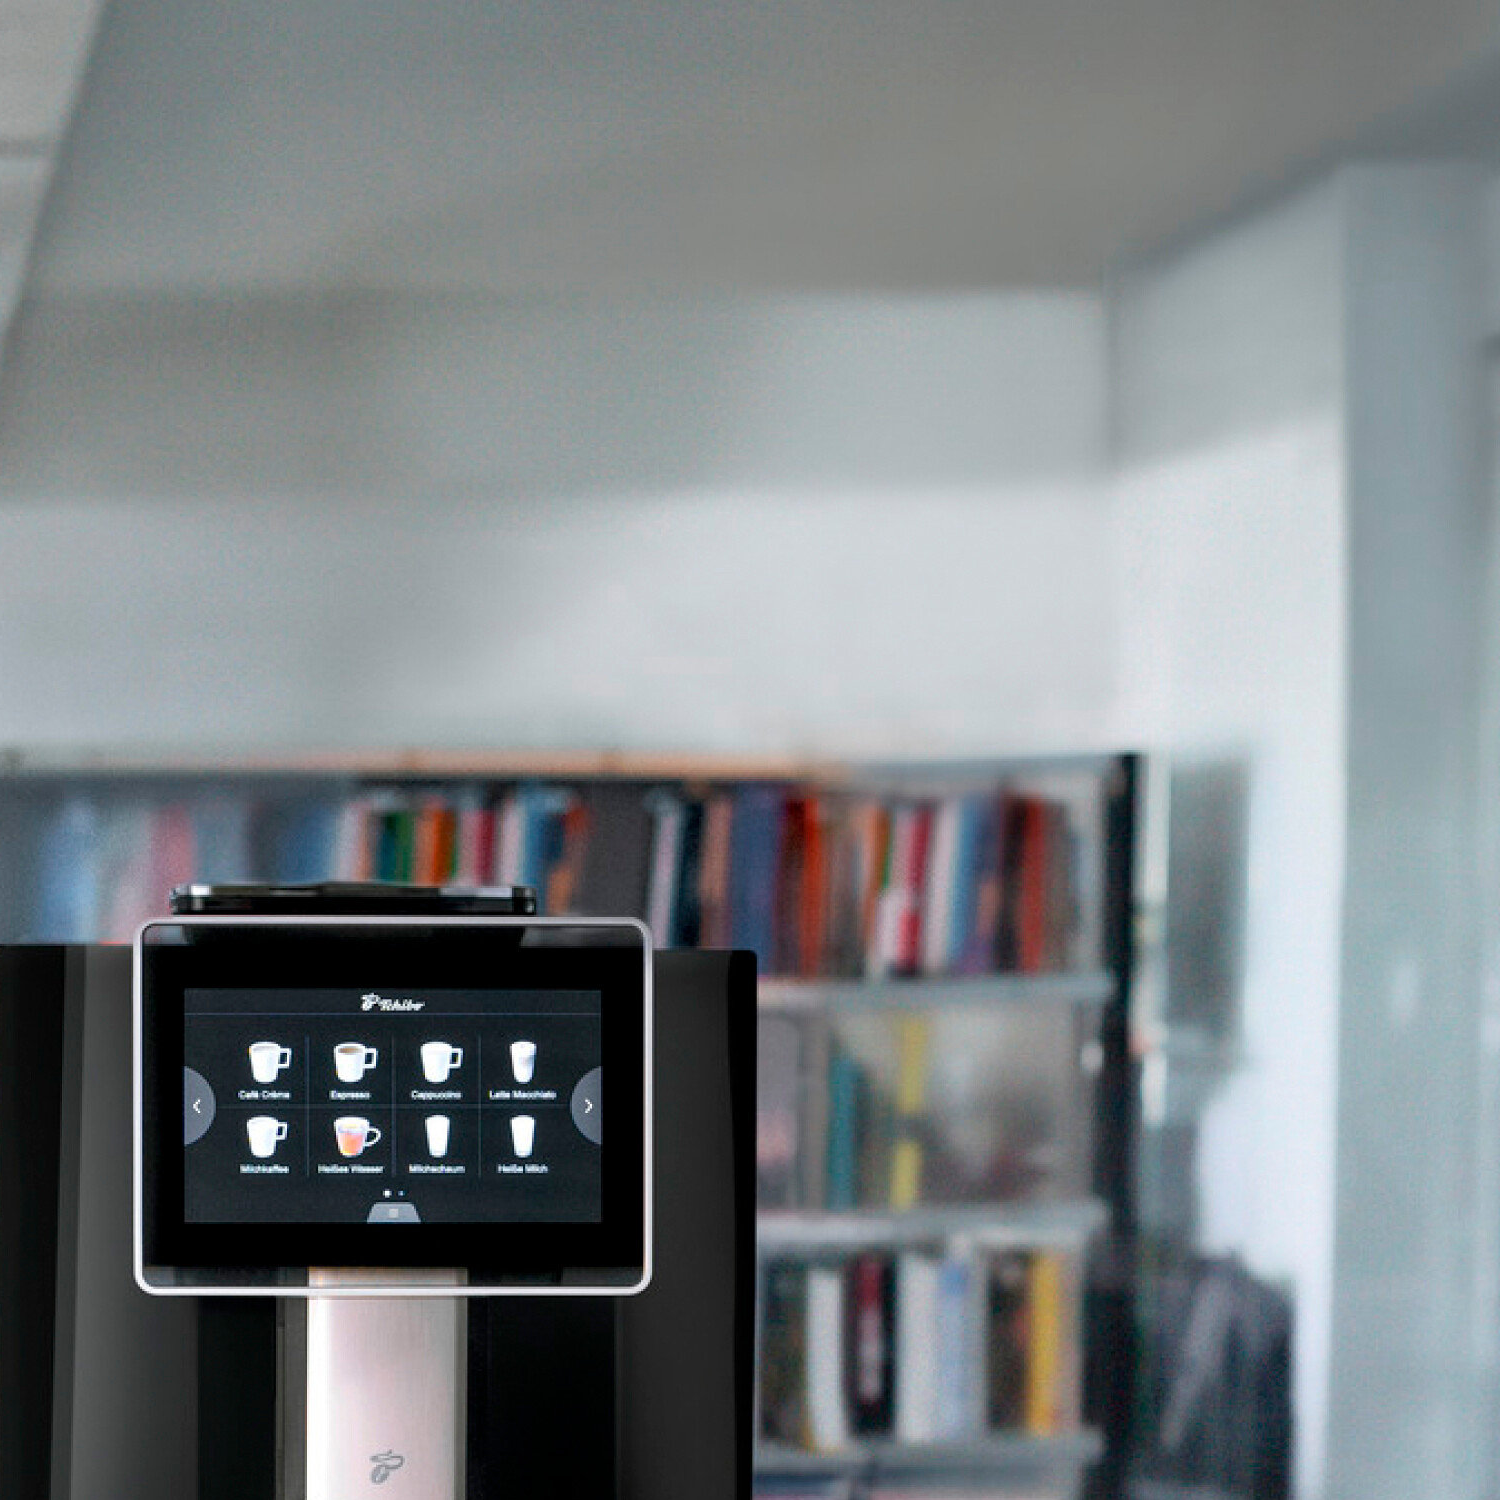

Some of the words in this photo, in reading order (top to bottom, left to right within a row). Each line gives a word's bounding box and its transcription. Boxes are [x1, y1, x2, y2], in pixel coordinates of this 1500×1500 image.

[379, 998, 426, 1011] Tchibo
[330, 1089, 371, 1100] Espresso
[411, 1089, 462, 1100] Cappuccino
[489, 1089, 511, 1099] Latte
